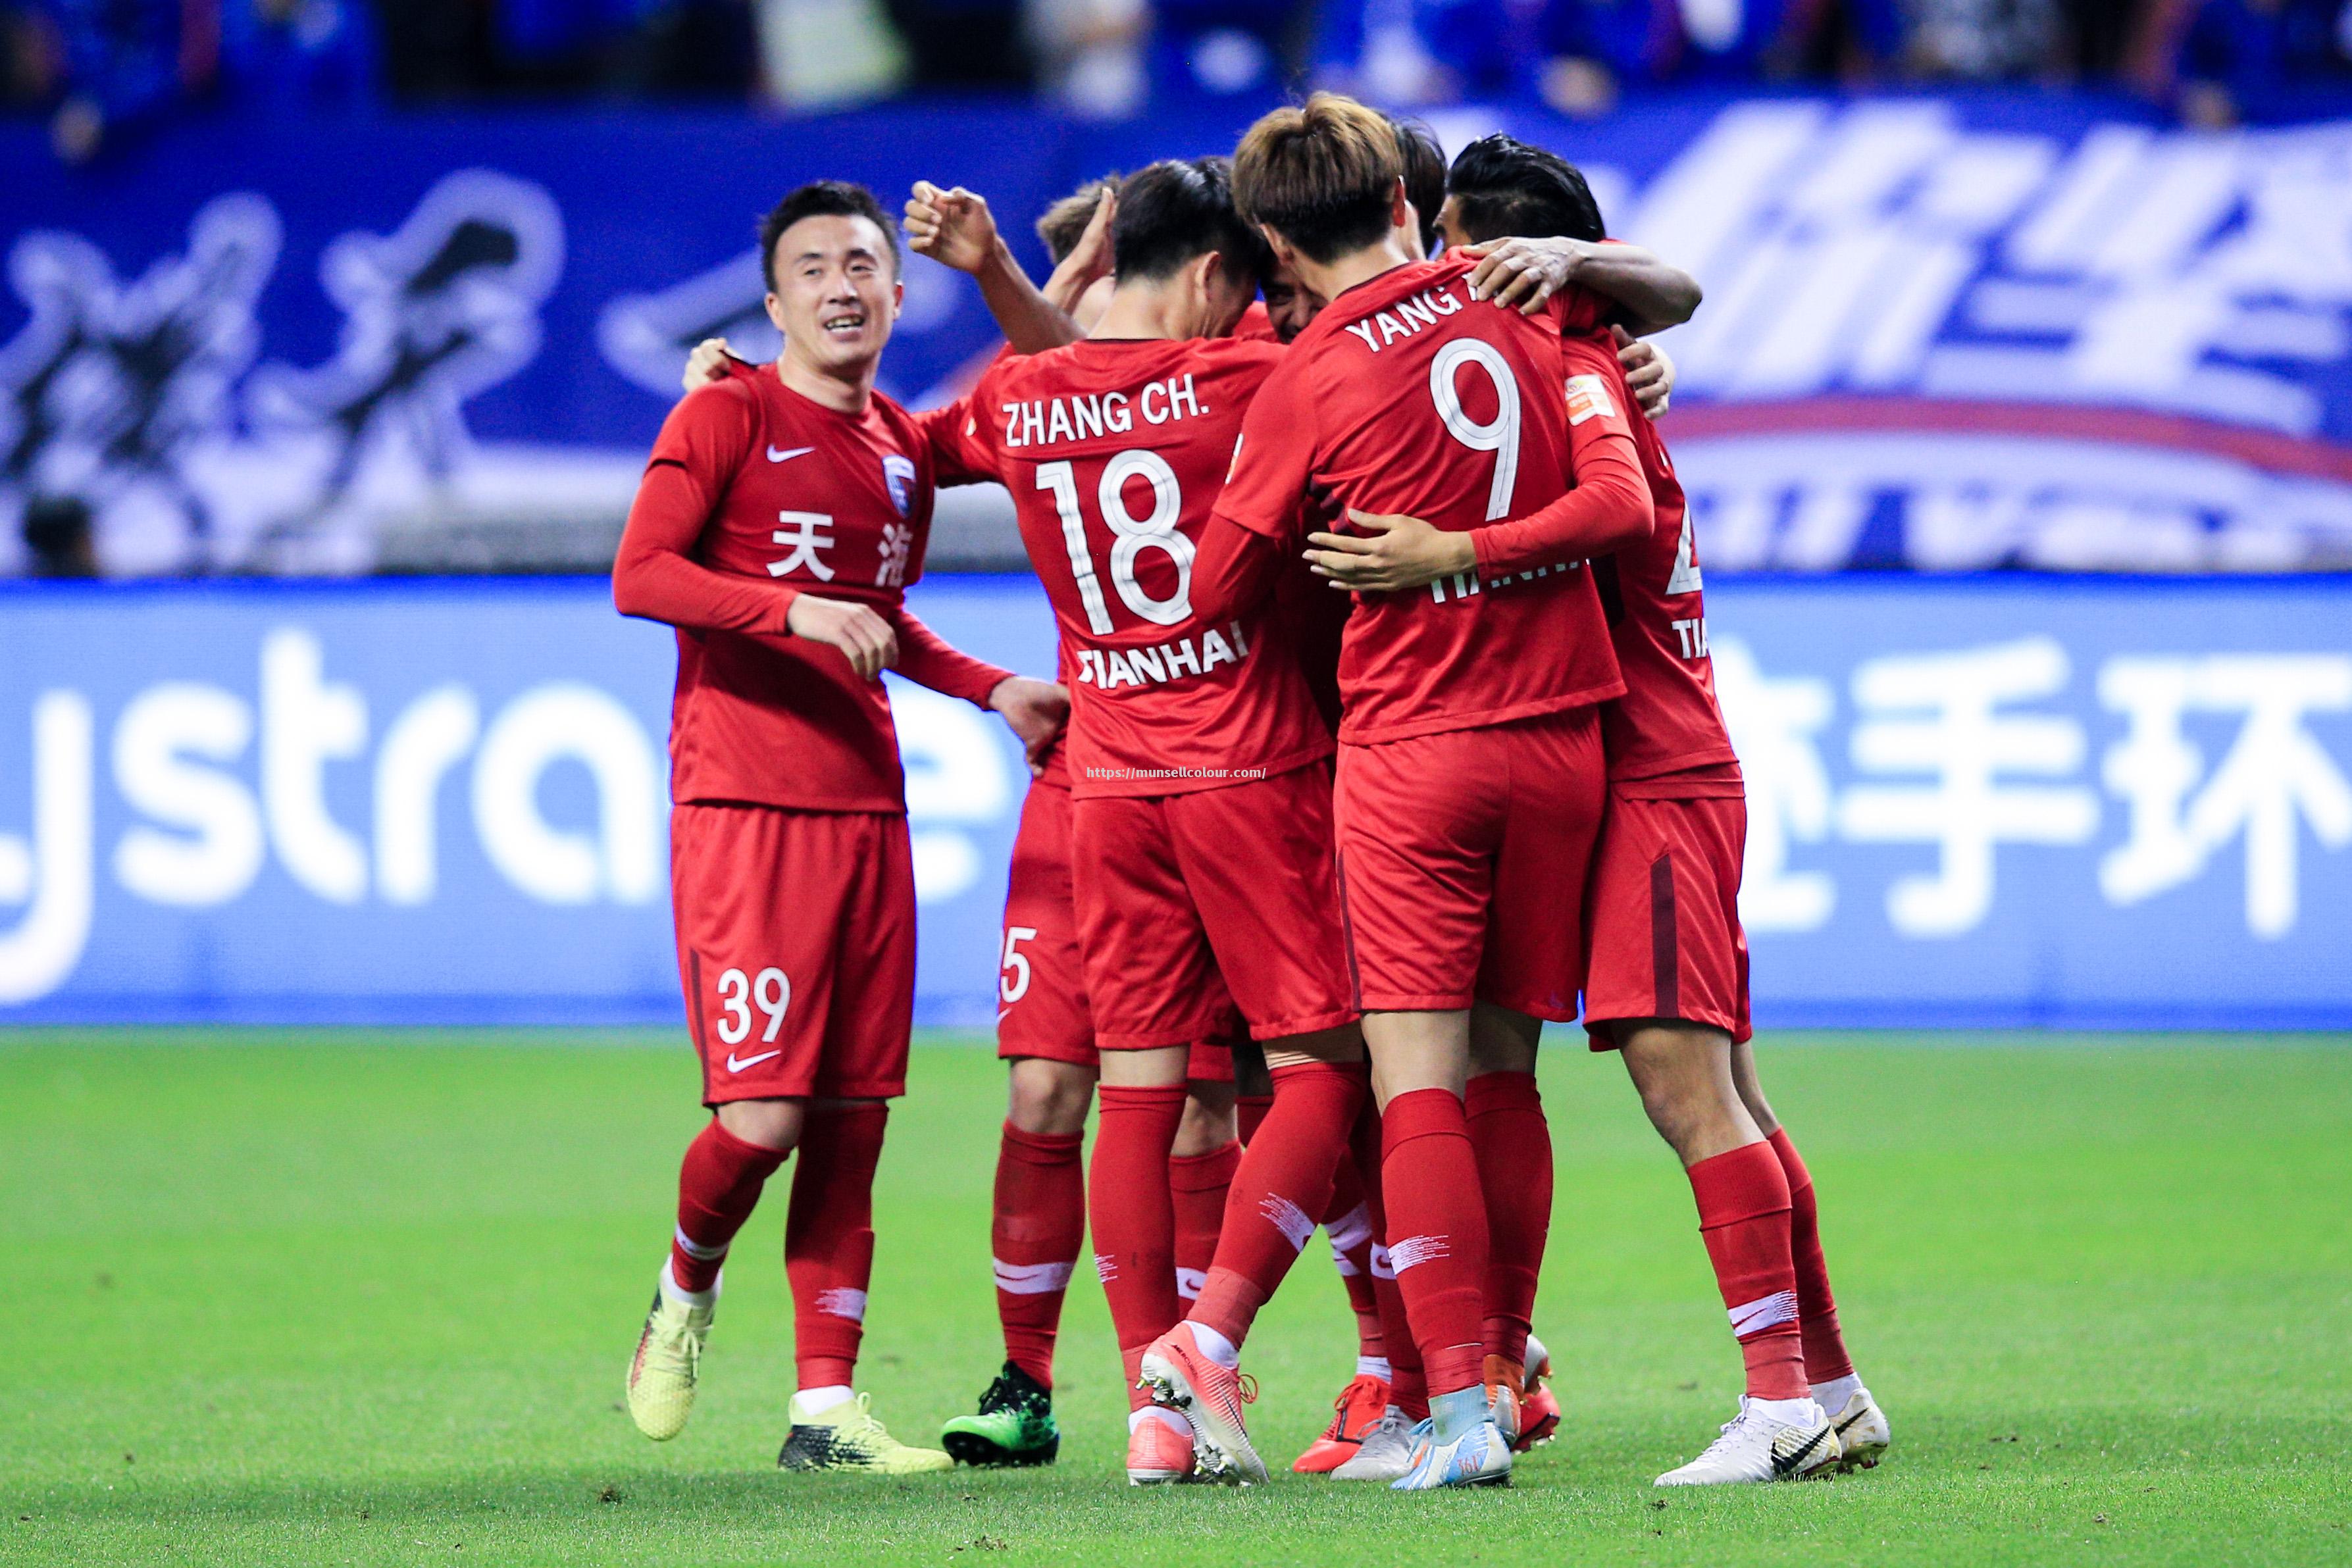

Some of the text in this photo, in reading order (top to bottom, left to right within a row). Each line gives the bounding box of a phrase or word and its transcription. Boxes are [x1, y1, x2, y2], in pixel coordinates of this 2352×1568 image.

[1344, 286, 1464, 353] YANG
[1002, 372, 1210, 447] ZHANG CH.
[1429, 337, 1521, 522] 9
[766, 510, 835, 582] 天
[1035, 449, 1196, 636] 18
[717, 967, 790, 1045] 39
